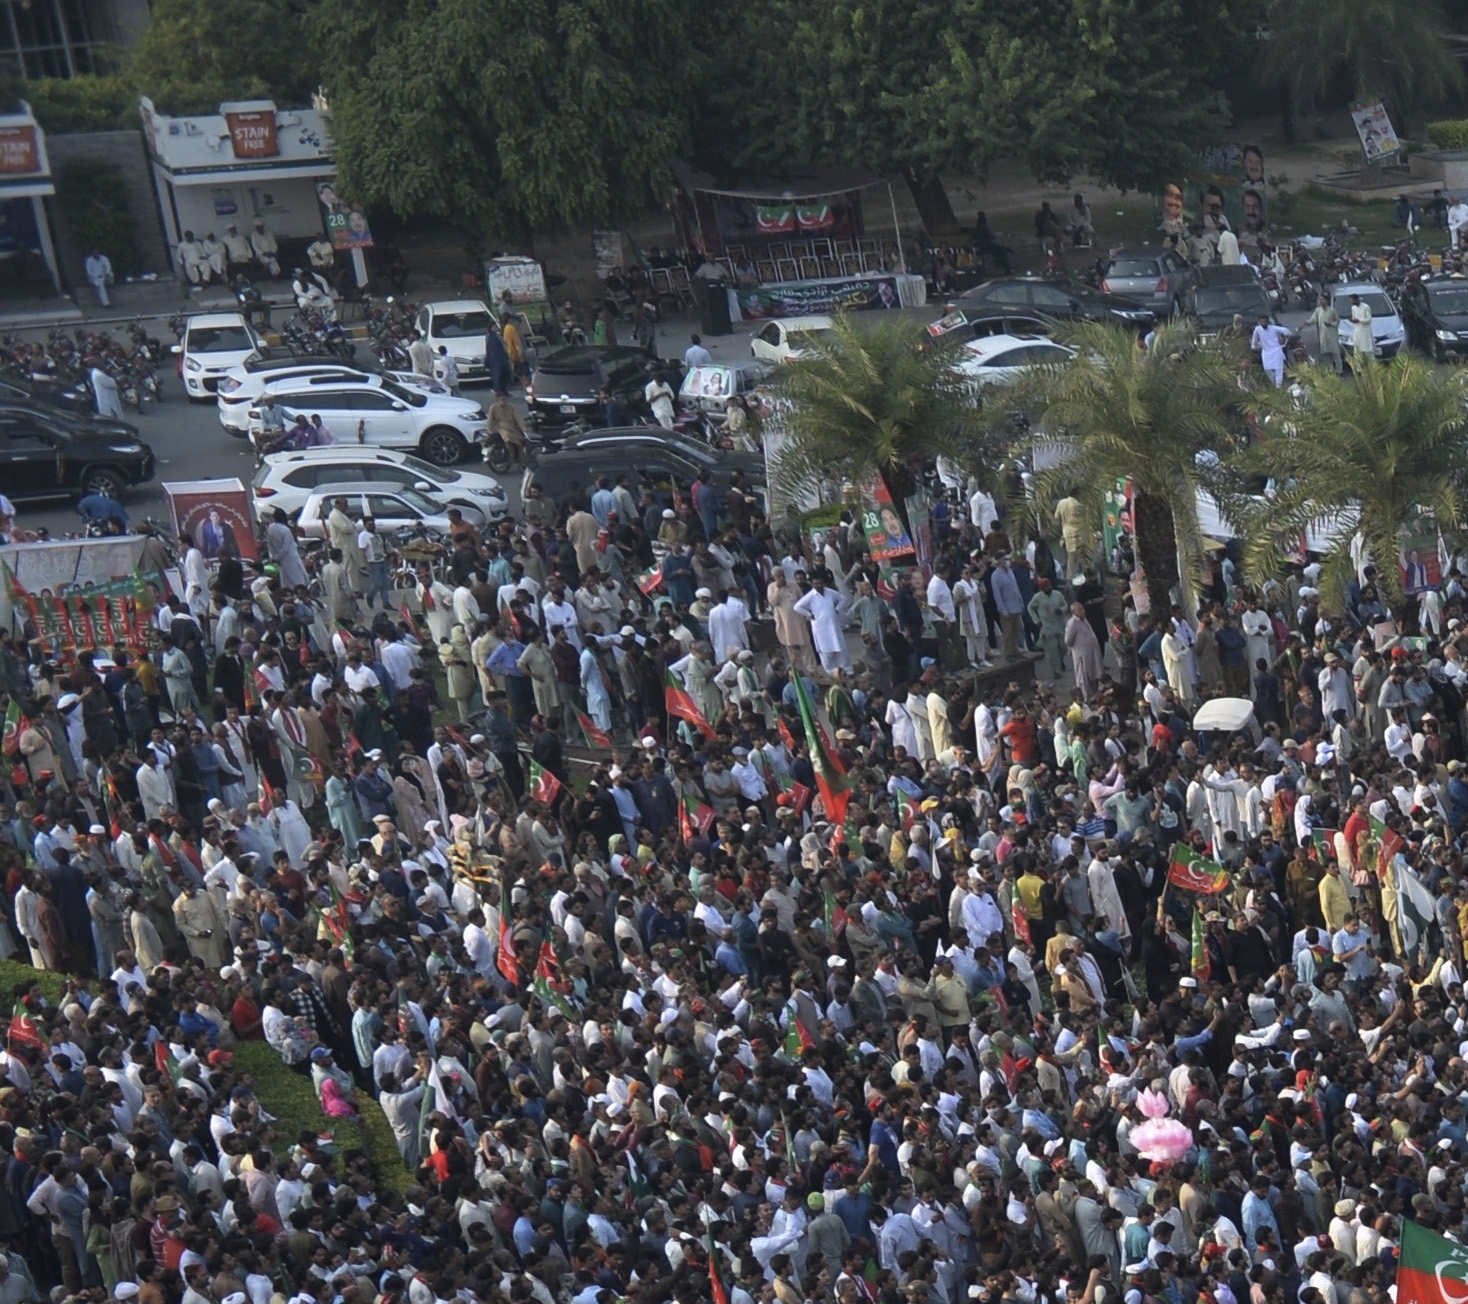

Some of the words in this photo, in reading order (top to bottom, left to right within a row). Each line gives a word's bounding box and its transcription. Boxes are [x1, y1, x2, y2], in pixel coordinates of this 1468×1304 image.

[235, 126, 269, 140] STAIN
[329, 215, 346, 227] 28
[862, 510, 880, 532] 28
